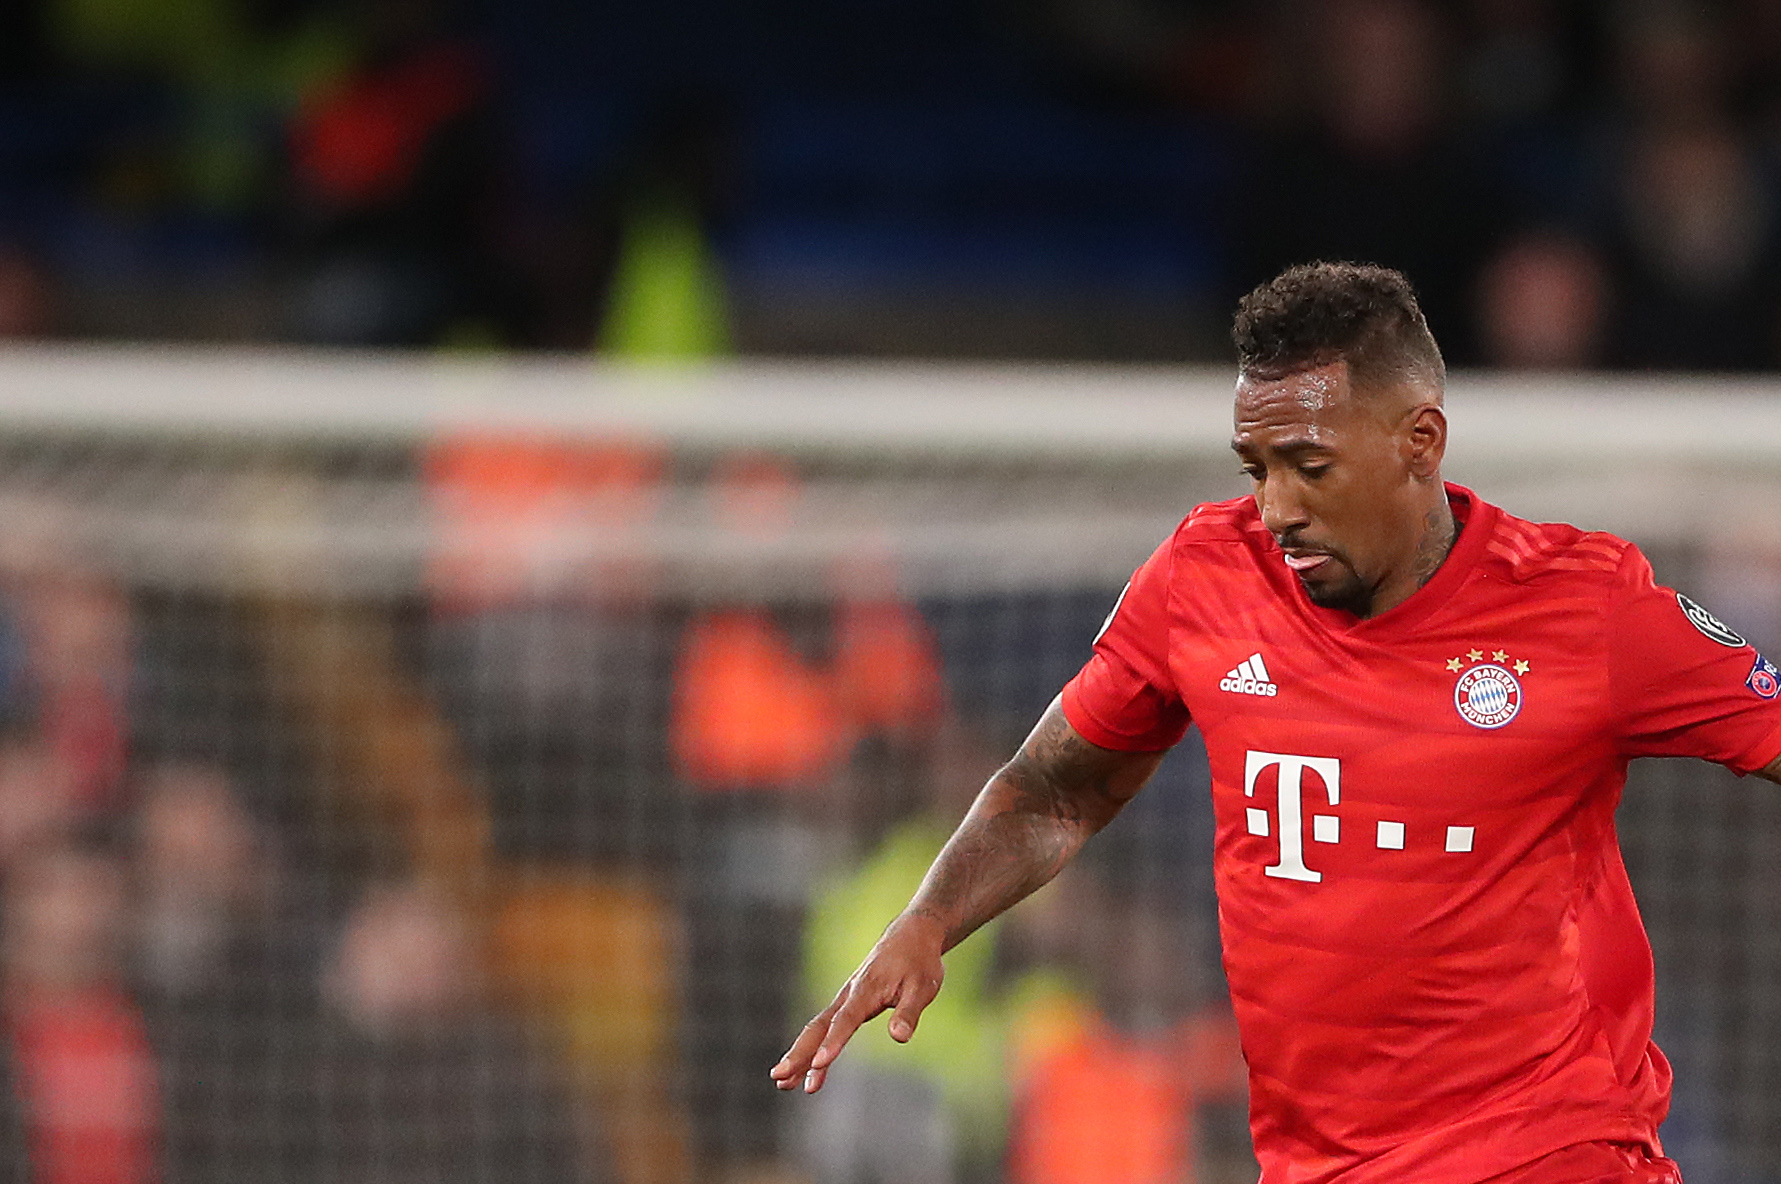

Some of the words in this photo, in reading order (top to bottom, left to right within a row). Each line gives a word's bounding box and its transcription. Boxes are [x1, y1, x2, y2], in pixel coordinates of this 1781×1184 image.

[1219, 677, 1278, 697] adidas
[1461, 676, 1474, 693] FC
[1473, 668, 1516, 693] BAYERN
